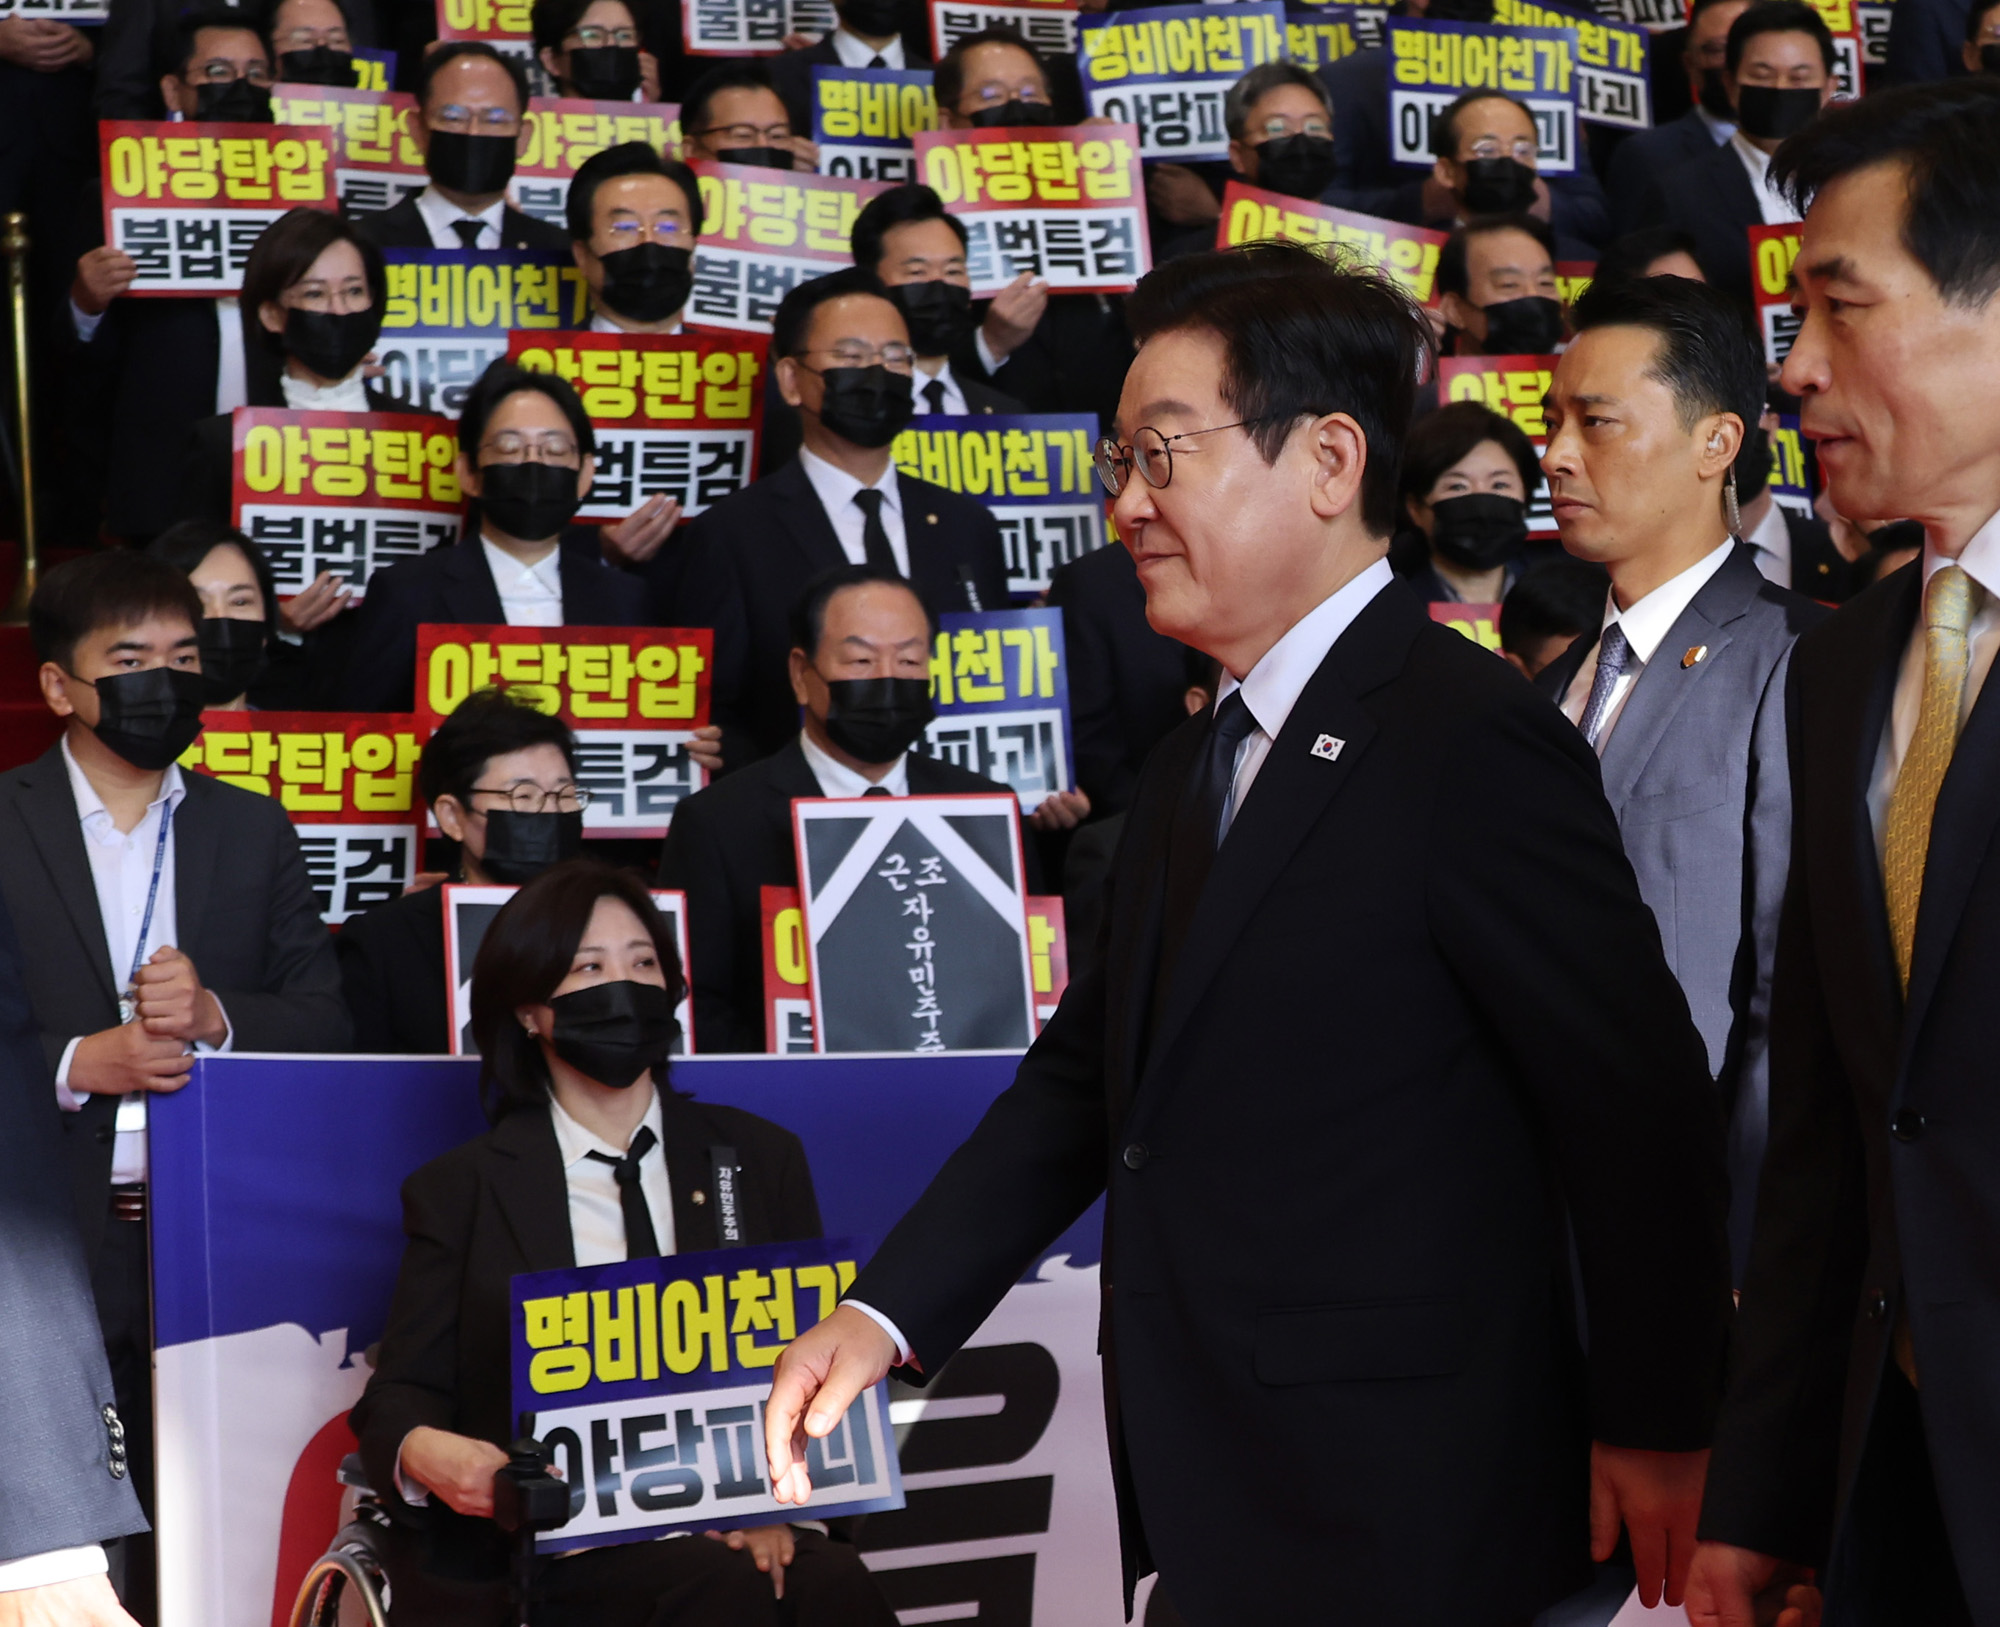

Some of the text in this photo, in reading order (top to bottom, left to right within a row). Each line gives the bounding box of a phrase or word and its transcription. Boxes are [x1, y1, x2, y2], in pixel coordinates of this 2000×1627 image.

[1082, 14, 1283, 82] 명비어천가
[1392, 29, 1574, 93] 명비어천가
[269, 96, 425, 166] 당탄
[515, 111, 684, 170] 야당탄
[109, 136, 328, 201] 야당탄압
[926, 139, 1134, 204] 야당탄압
[697, 175, 876, 253] 야당탄
[693, 255, 829, 320] 불법
[244, 425, 462, 503] 야당탄압
[428, 642, 704, 719] 야당탄압
[917, 722, 1059, 789] 파괴
[878, 853, 948, 892] 근조
[523, 1261, 859, 1394] 명비어천가
